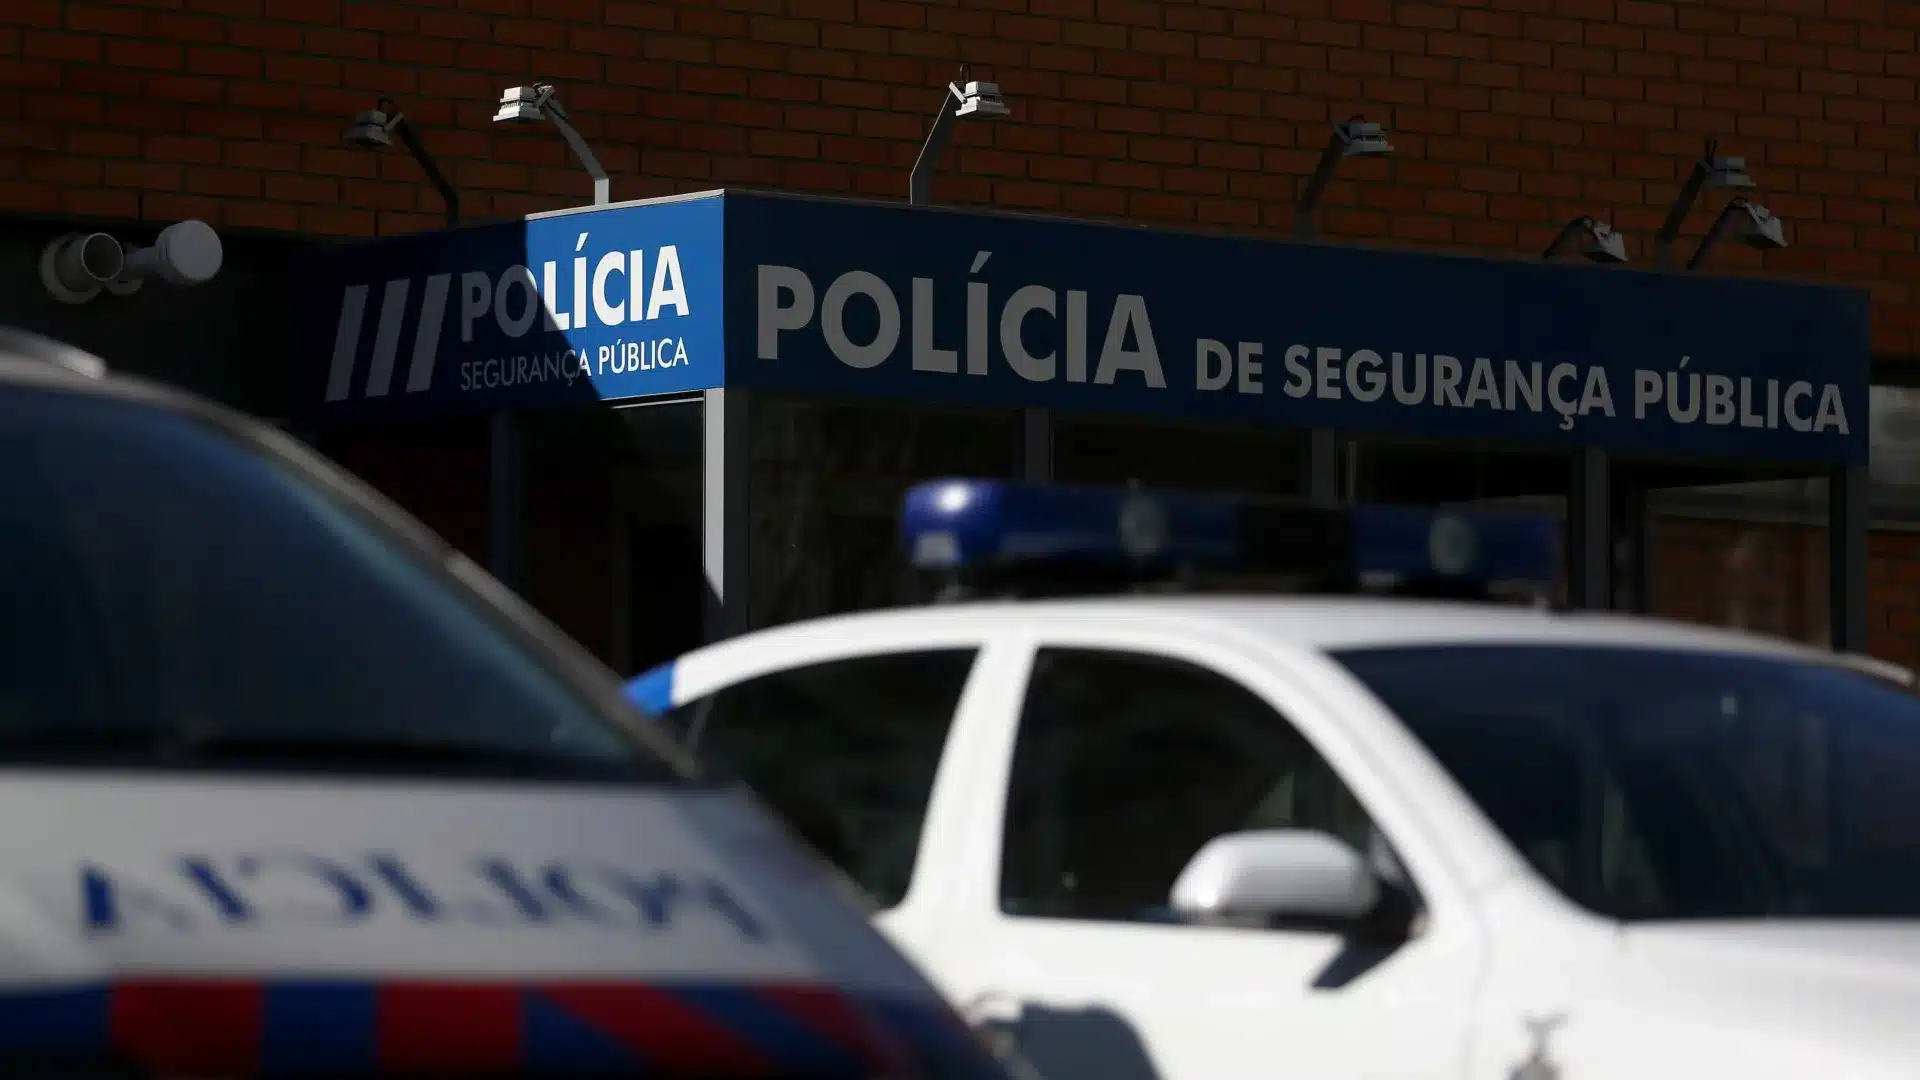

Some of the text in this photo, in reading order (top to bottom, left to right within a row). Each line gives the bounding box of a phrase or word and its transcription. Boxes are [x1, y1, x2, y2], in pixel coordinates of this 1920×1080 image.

[460, 232, 690, 344] POLÍCIA
[757, 250, 1850, 436] POLÍCIA DE SEGURANÇA PÚBLICA
[460, 338, 689, 392] SEGURANÇA PÚBLICA
